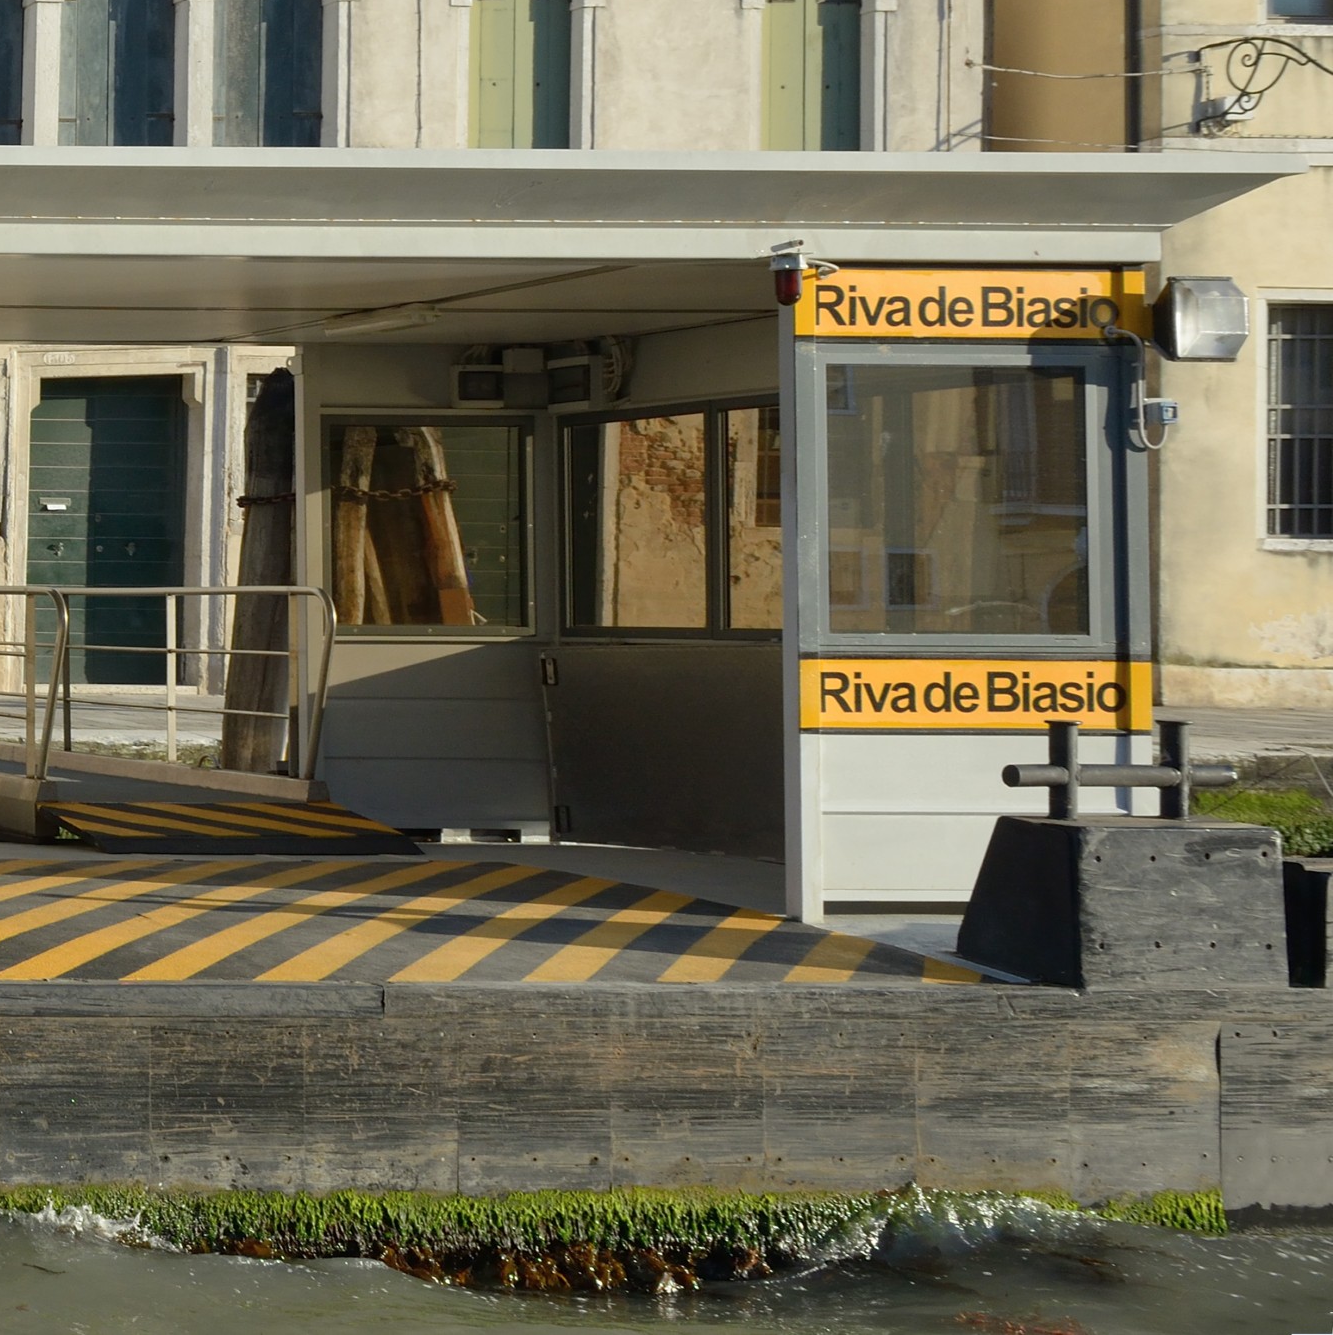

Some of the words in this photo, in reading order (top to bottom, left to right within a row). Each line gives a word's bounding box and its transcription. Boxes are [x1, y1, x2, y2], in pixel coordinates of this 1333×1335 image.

[815, 284, 911, 327] Riva
[919, 285, 973, 327] de
[982, 286, 1119, 329] Biasio
[820, 671, 916, 713] Riva
[924, 671, 979, 713] de
[987, 671, 1127, 714] Biasio
